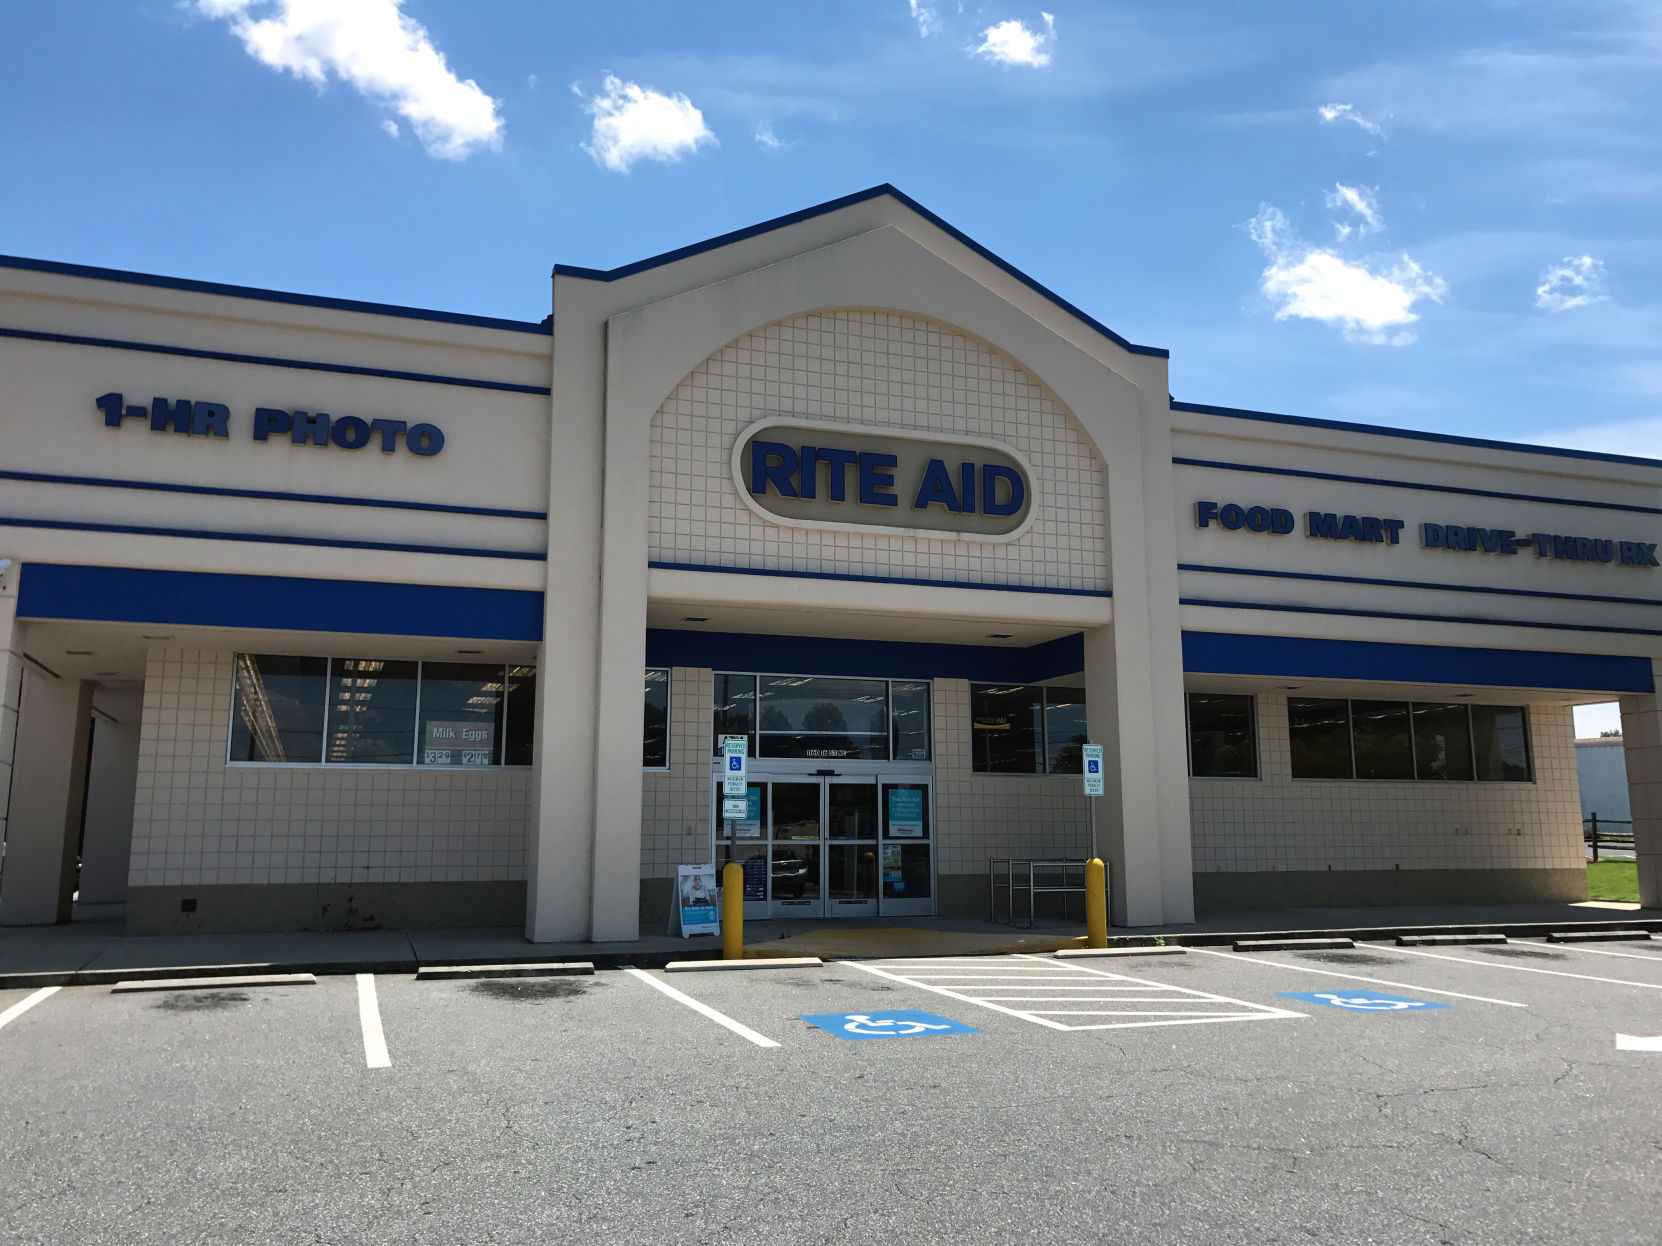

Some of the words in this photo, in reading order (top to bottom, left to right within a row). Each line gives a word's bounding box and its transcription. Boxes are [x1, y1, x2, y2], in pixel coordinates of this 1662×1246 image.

[96, 392, 230, 440] 1-HR
[253, 407, 445, 457] PHOTO
[751, 440, 898, 507] RITE
[912, 458, 1025, 516] AID
[1195, 501, 1295, 535] FOOD
[1305, 511, 1404, 545] MART
[1420, 522, 1614, 563] DRIVE-THRU
[1617, 540, 1661, 567] RX
[433, 727, 456, 739] Milk
[462, 728, 488, 742] Eggs
